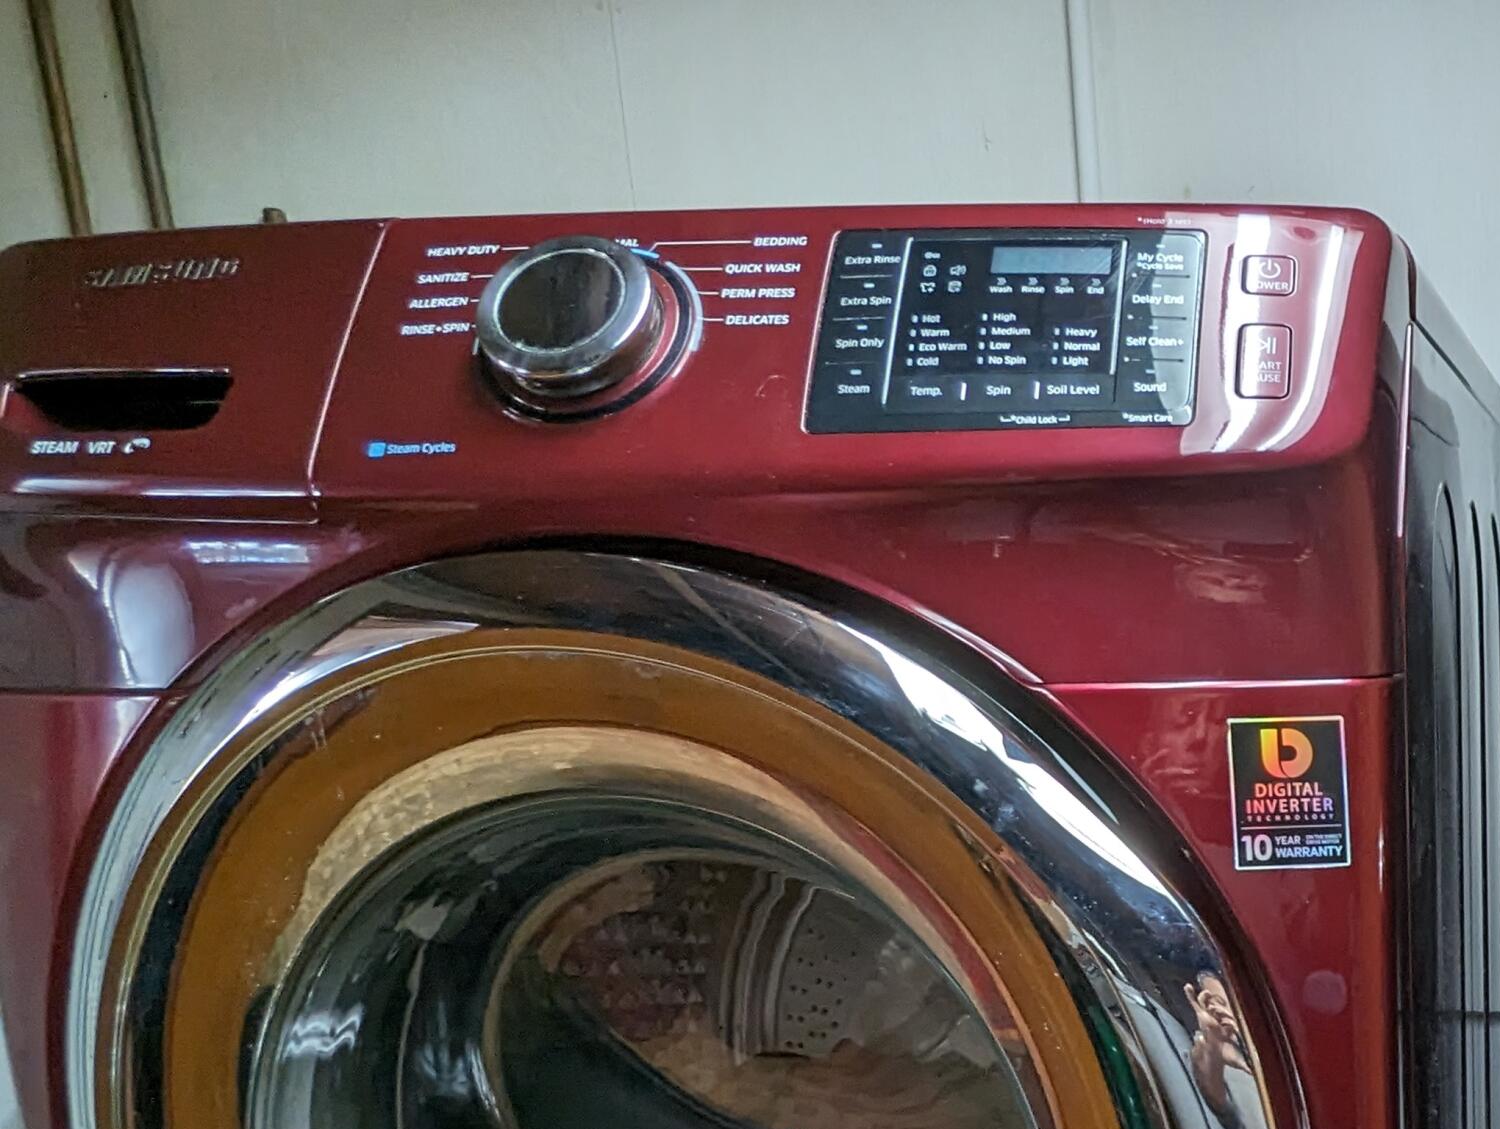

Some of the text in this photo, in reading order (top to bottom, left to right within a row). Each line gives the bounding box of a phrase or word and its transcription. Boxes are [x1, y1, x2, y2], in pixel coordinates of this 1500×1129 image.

[753, 236, 808, 247] BEDDING
[427, 243, 499, 257] HEAVY DUTY
[845, 255, 901, 265] Extra Rinse
[1137, 252, 1184, 262] My Cycle
[725, 262, 801, 275] QUICK WASH
[417, 271, 469, 284] SANITIZE
[989, 286, 1013, 294] Wash
[1021, 286, 1045, 294] Rinse
[1055, 286, 1074, 294] Spin
[1087, 286, 1104, 294] End
[1257, 281, 1289, 291] OWER
[721, 287, 795, 299] PERM PRESS
[408, 296, 468, 309] ALLERGEN
[840, 296, 892, 306] Extra Spin
[1132, 294, 1184, 305] Delay End
[725, 315, 789, 326] DELICATES
[922, 314, 941, 323] Hot
[993, 313, 1016, 322] High
[920, 329, 950, 337] Warm
[991, 327, 1031, 336] Medium
[1066, 327, 1098, 338] Heavy
[835, 338, 885, 349] Spin Only
[989, 341, 1011, 350] Low
[1126, 336, 1147, 346] Self
[919, 343, 968, 351] Eco Warm
[1064, 342, 1101, 351] Normal
[916, 357, 939, 366] Cold
[988, 355, 1027, 366] No Spin
[1063, 356, 1089, 367] Light
[837, 384, 870, 394] Steam
[910, 386, 943, 397] Temp.
[986, 385, 1011, 396] Spin
[1047, 385, 1100, 395] Soil Level
[1134, 382, 1168, 392] Sound
[1015, 415, 1058, 425] Child Lock
[1128, 413, 1173, 422] Smart Care
[32, 441, 79, 454] STEAM
[88, 441, 116, 454] VRT
[386, 442, 456, 454] Steam Cycles
[1254, 782, 1323, 798] DIGITAL
[1245, 797, 1334, 814] INVERTER
[1246, 813, 1335, 822] TECHNOLOGY
[1240, 834, 1301, 861] 10 YEAR
[1274, 845, 1343, 858] WARRANTY
